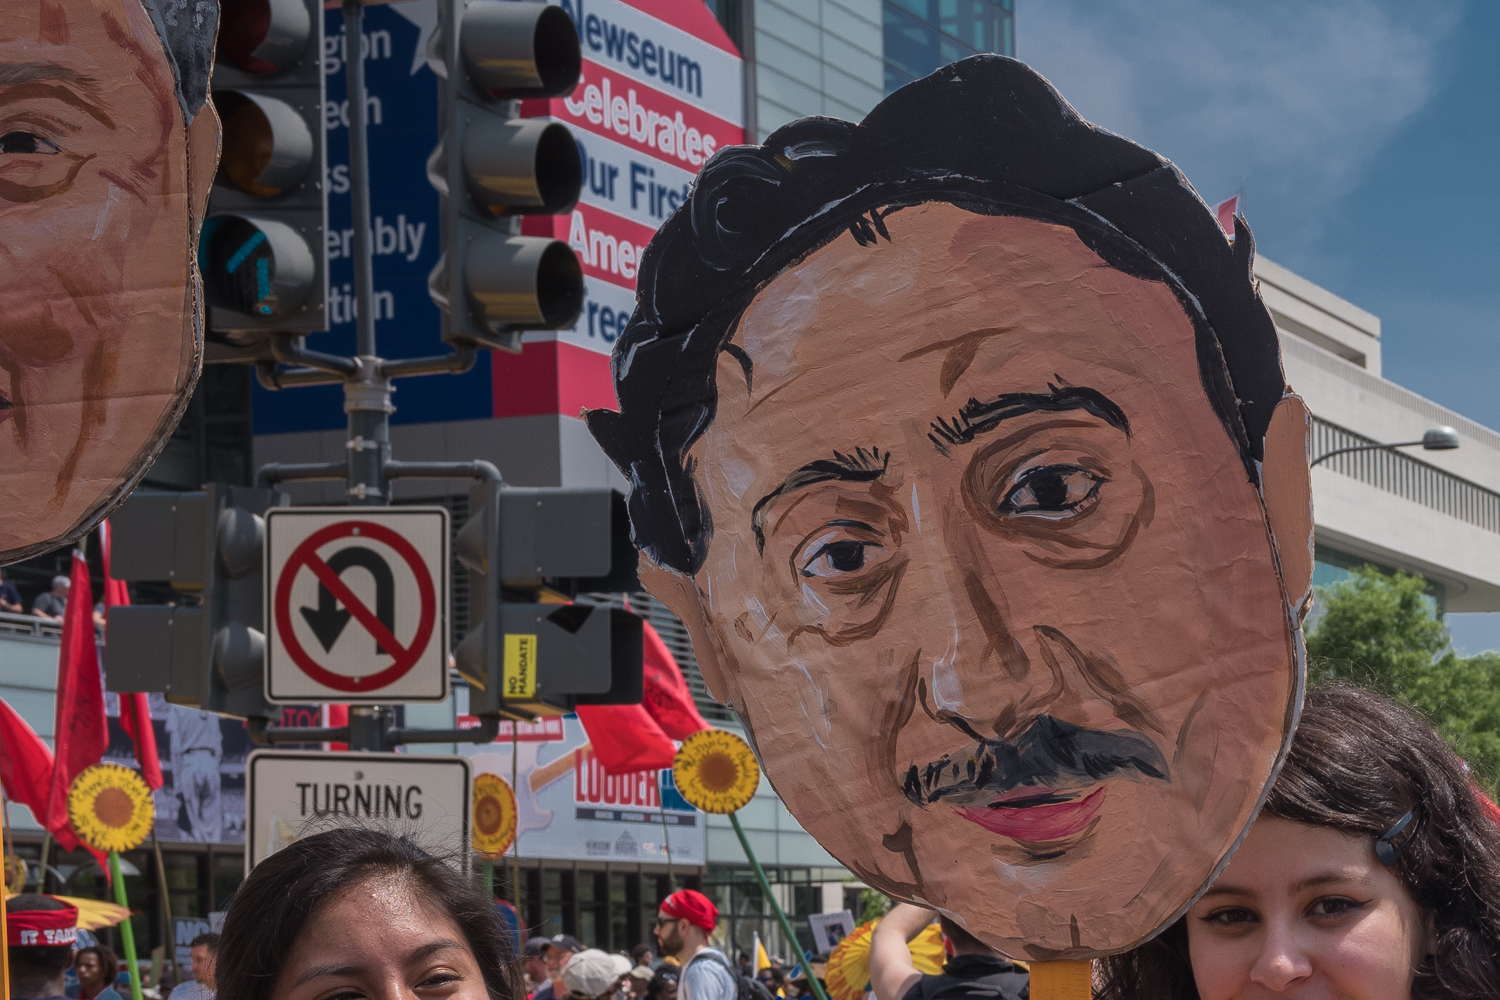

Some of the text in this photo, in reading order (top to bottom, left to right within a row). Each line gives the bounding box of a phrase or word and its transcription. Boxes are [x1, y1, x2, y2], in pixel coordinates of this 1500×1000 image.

[577, 138, 619, 202] ur
[508, 676, 517, 694] NO
[519, 638, 528, 694] MANDATE
[295, 783, 423, 820] TURNING
